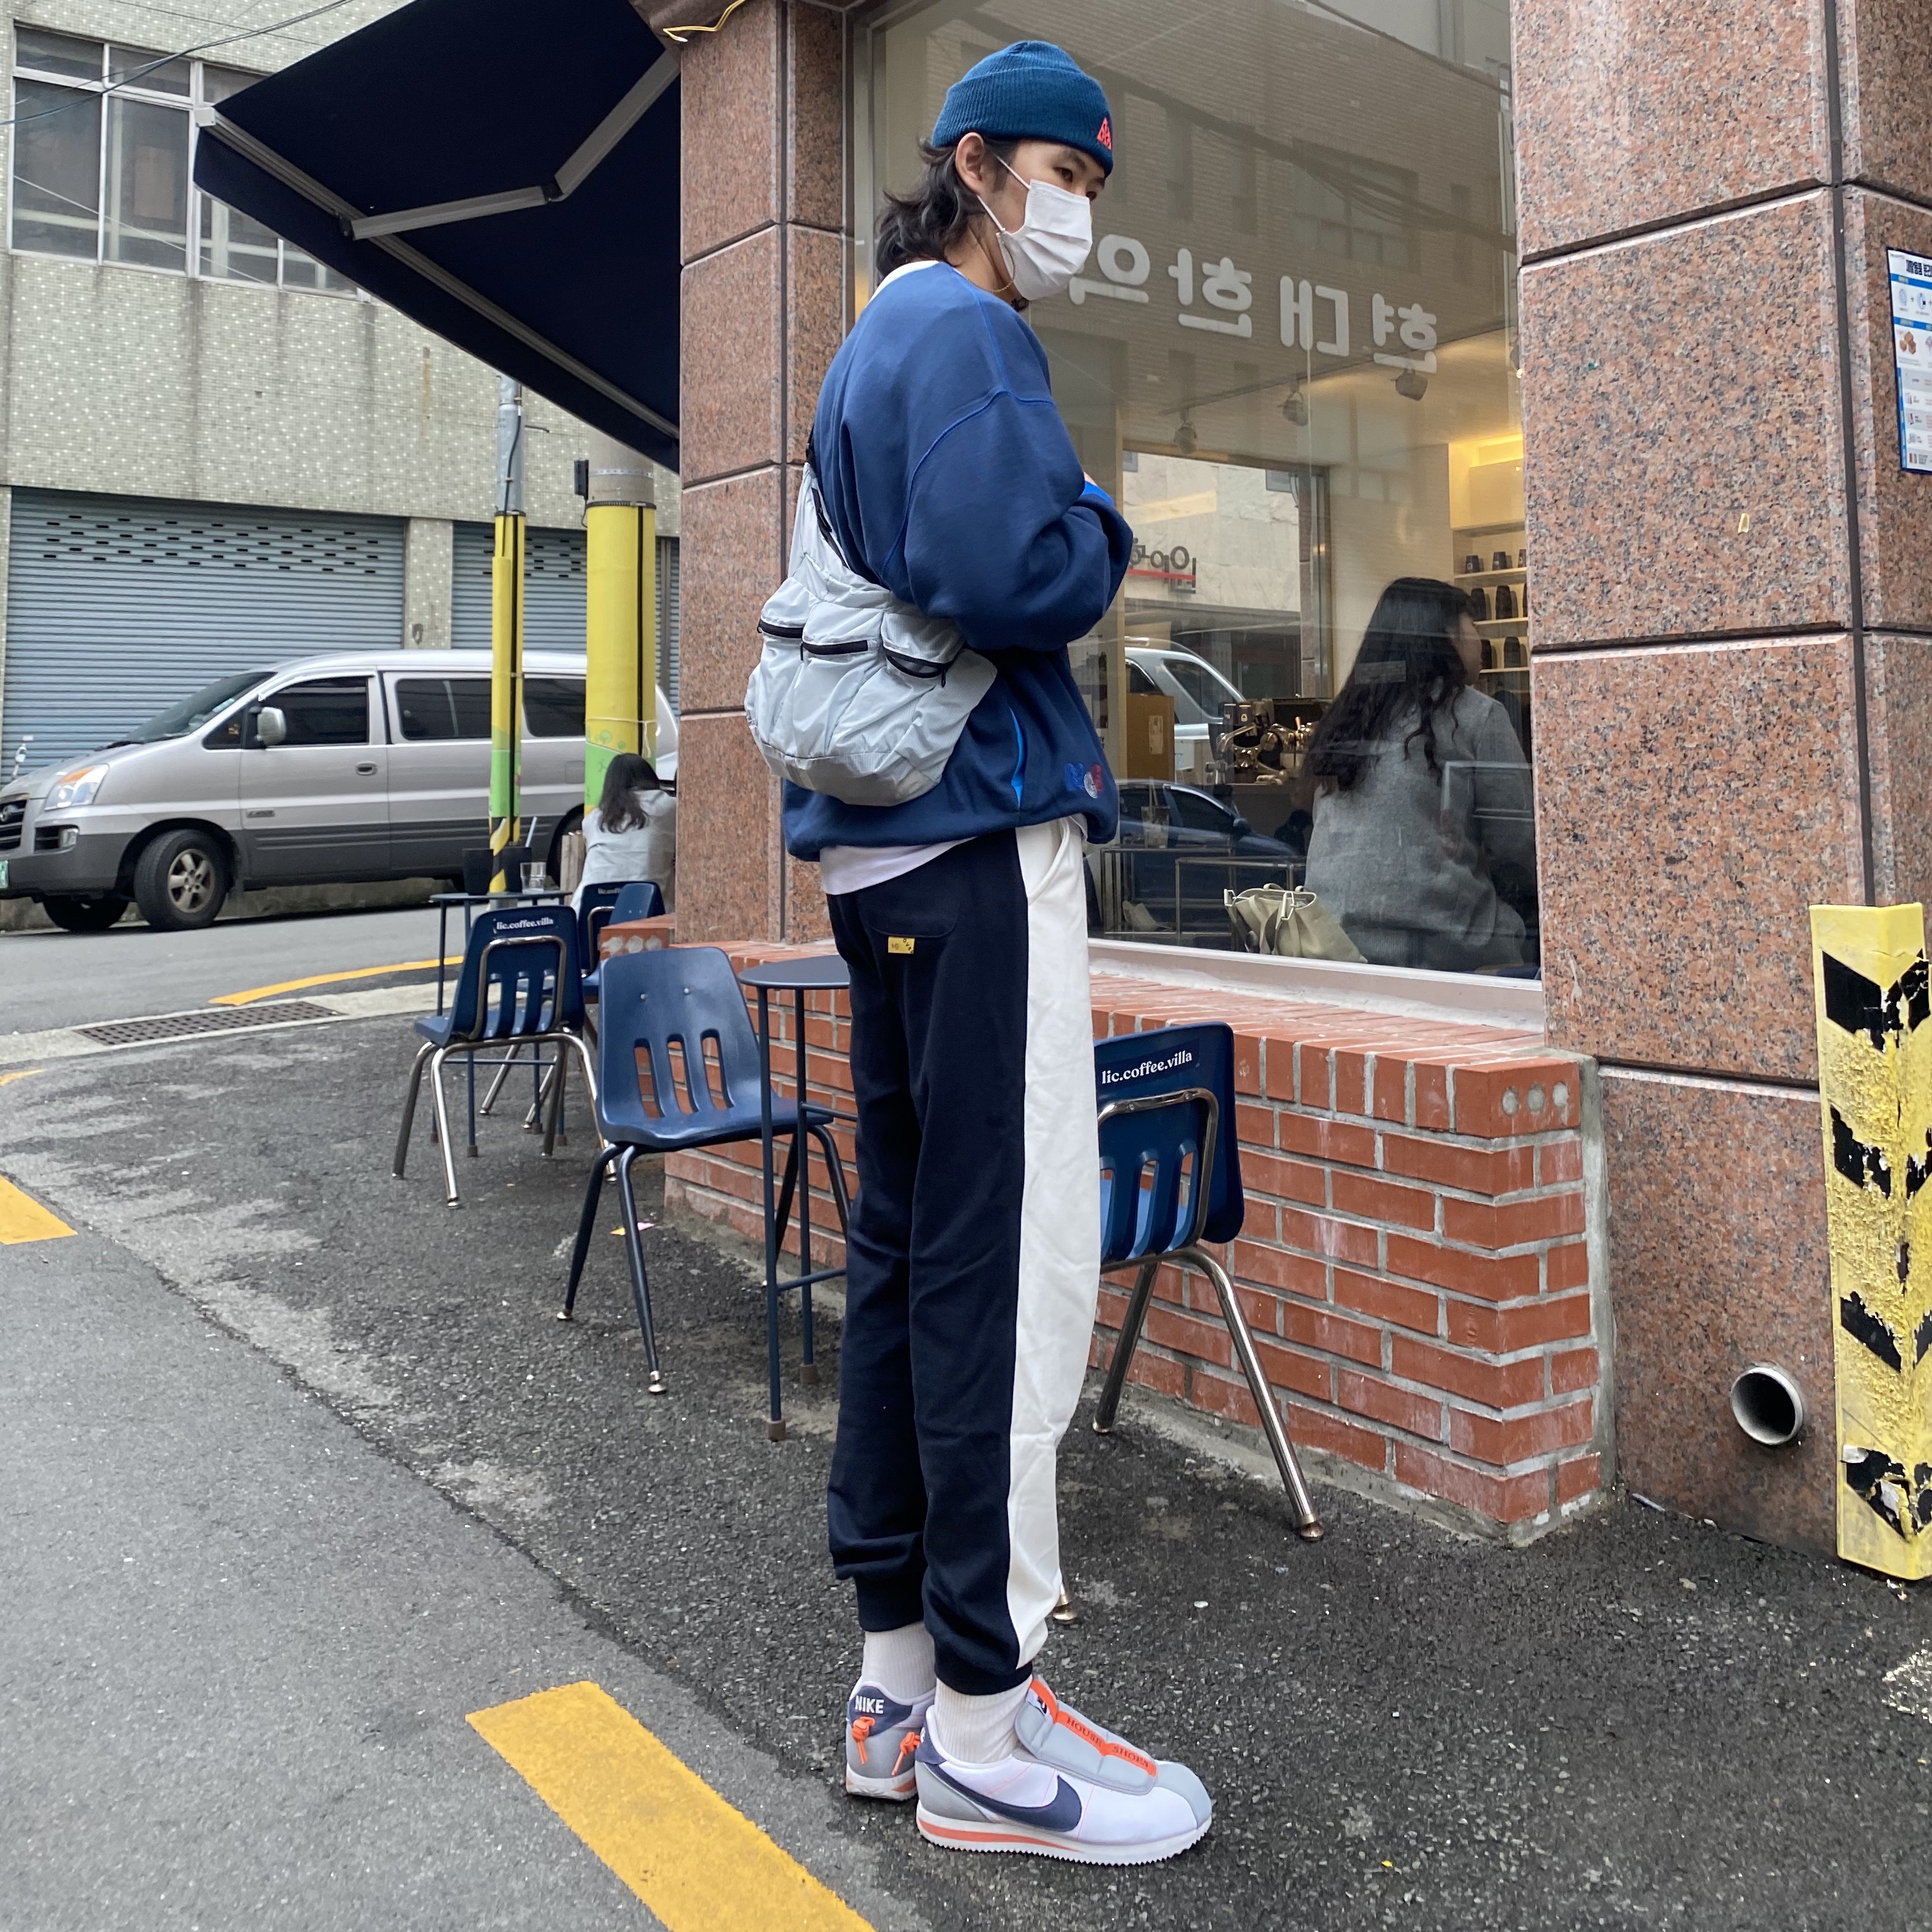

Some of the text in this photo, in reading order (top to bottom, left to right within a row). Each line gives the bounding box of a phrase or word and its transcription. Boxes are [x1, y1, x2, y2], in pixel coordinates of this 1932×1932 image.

[496, 917, 554, 930] lic.coffee.villa
[1101, 1050, 1193, 1084] lic.coffee.villa
[855, 1695, 885, 1714] NIKE
[1067, 1717, 1149, 1768] HOUSE SHOES
